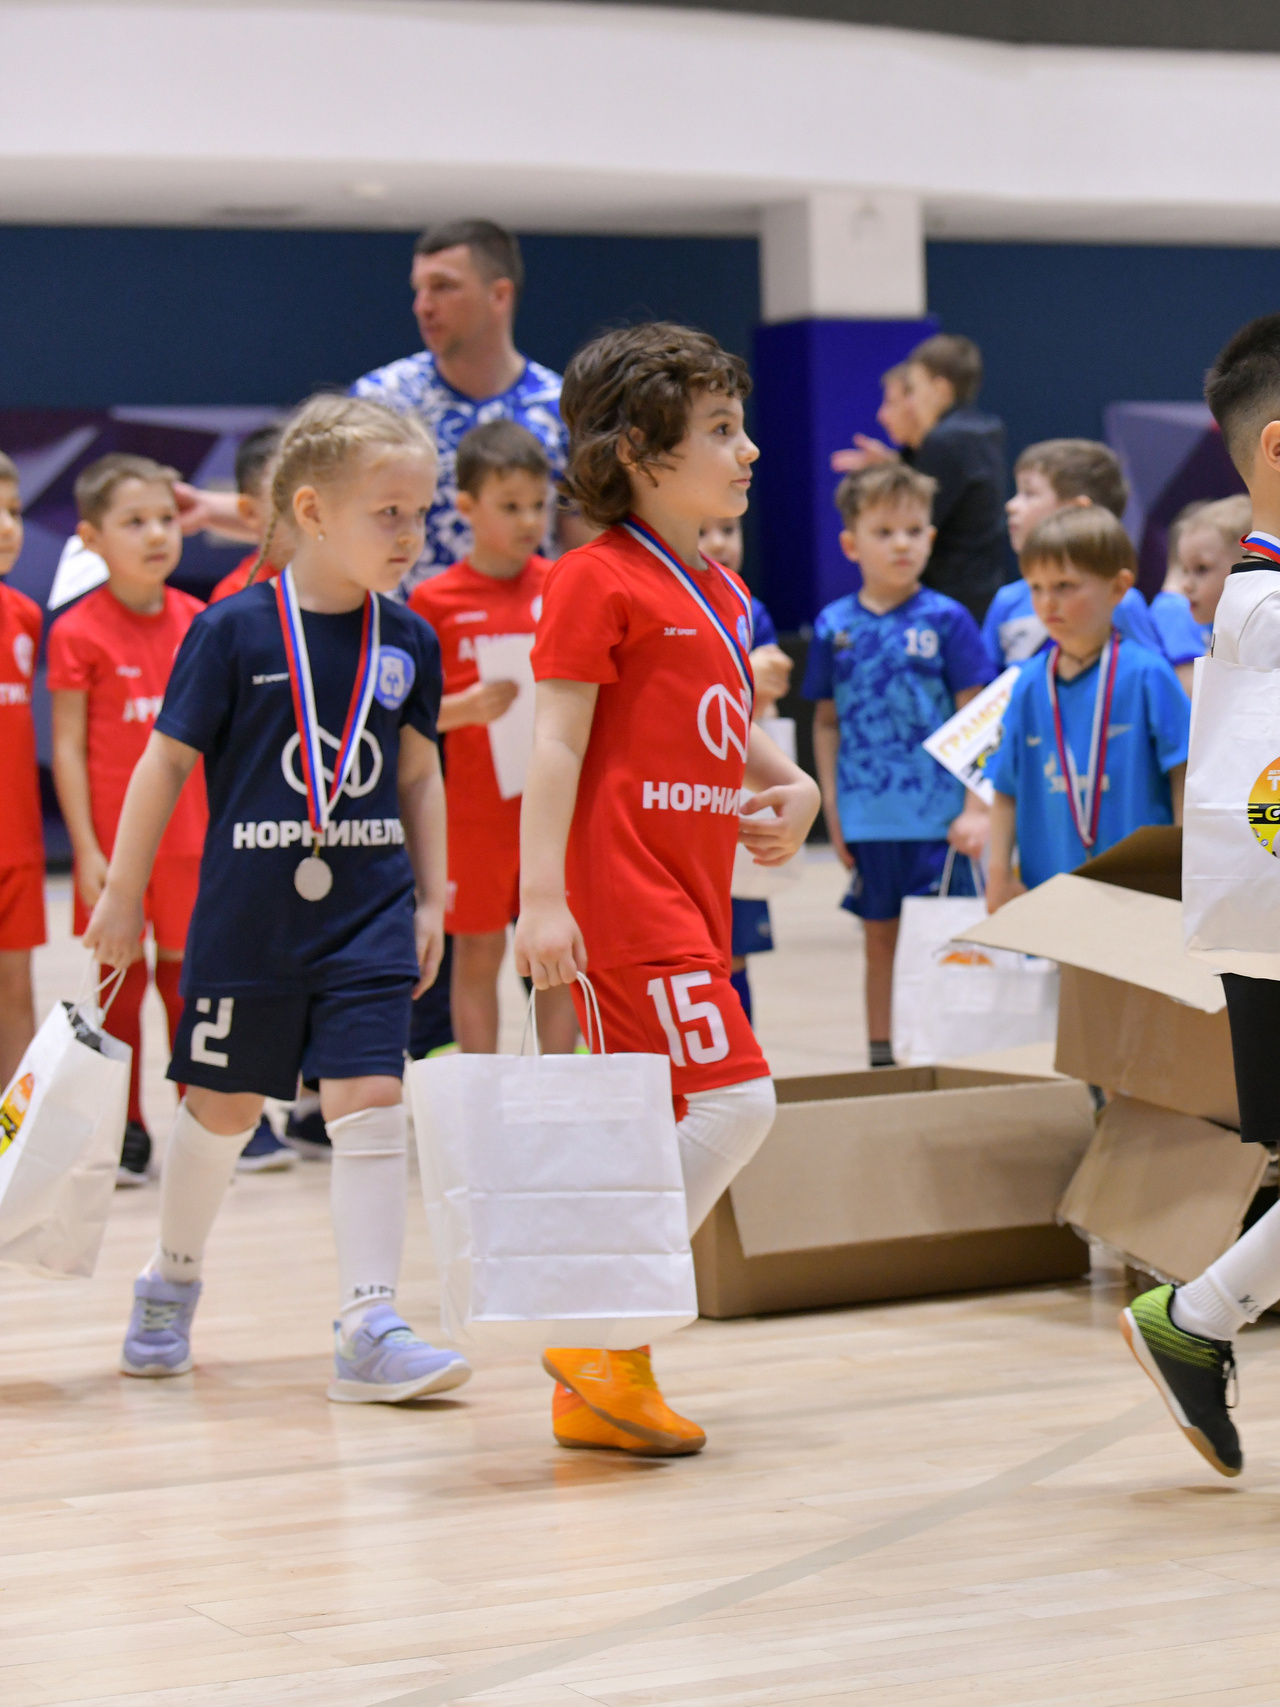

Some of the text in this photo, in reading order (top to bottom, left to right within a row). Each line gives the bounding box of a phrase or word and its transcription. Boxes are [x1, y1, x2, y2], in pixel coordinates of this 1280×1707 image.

[904, 628, 939, 658] 19
[190, 997, 235, 1068] 2
[647, 970, 730, 1067] 15
